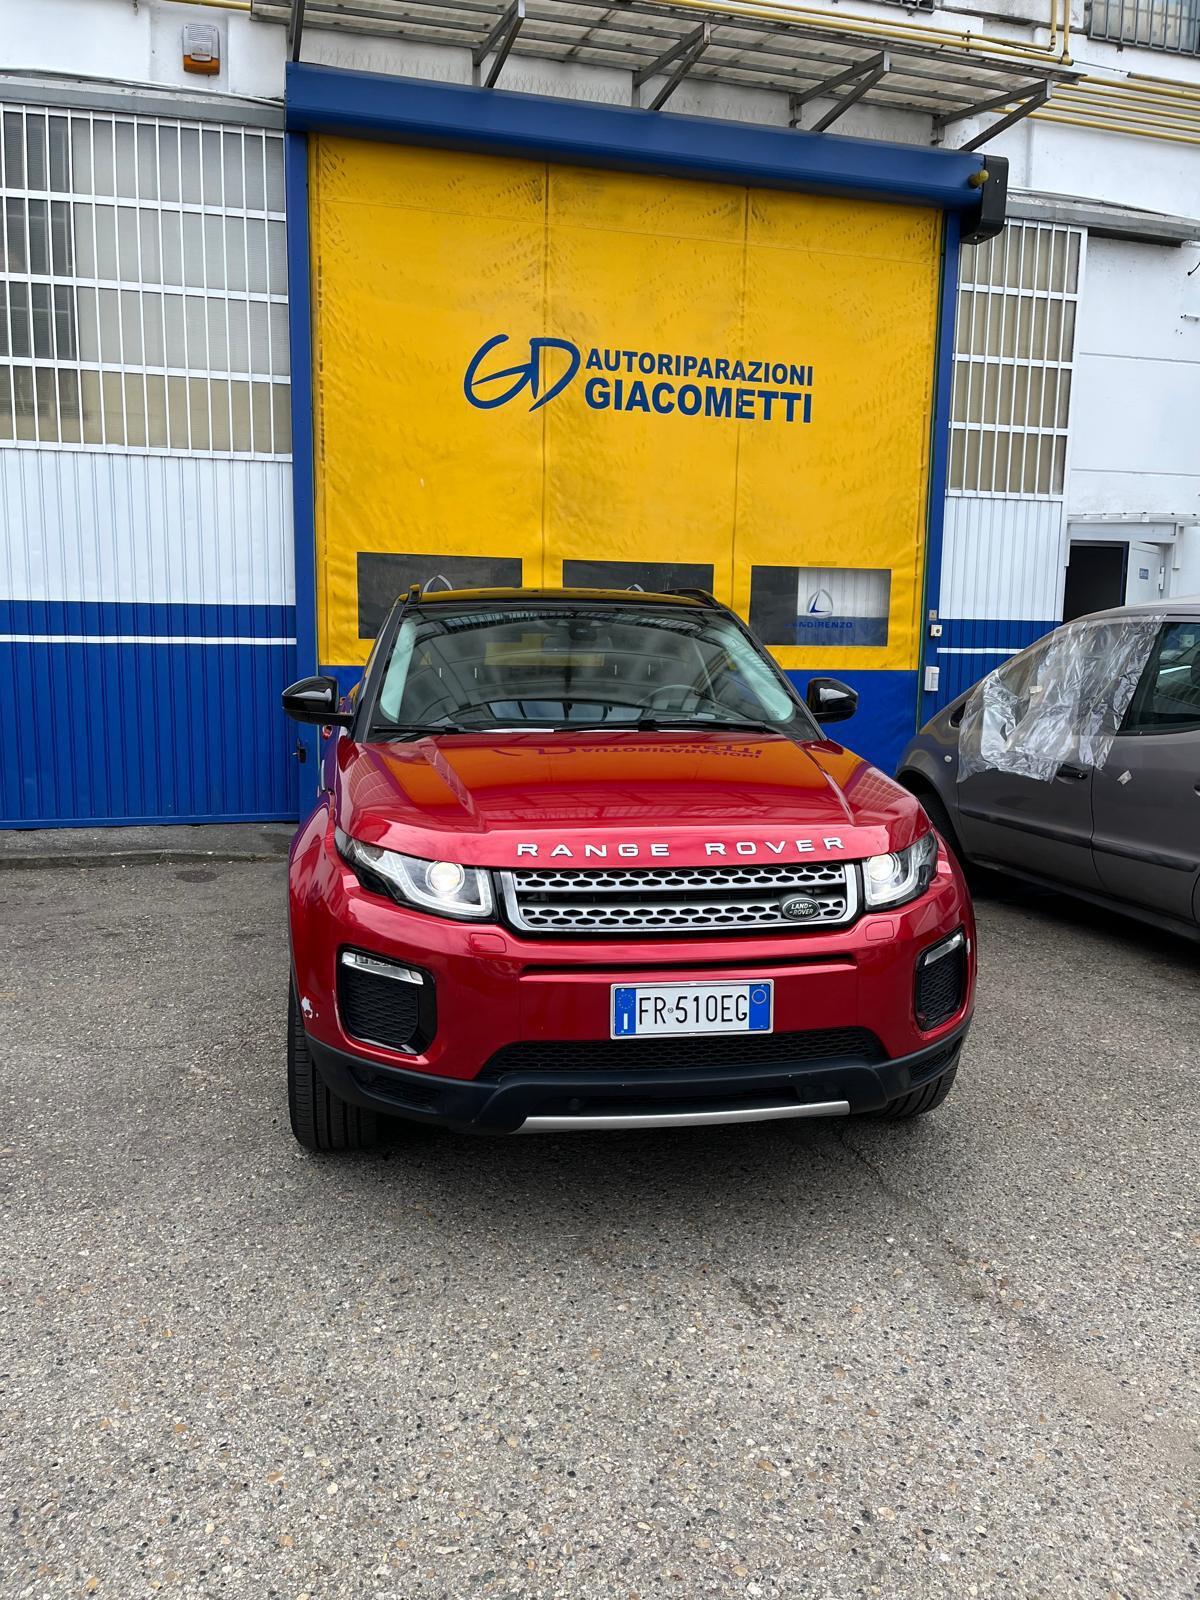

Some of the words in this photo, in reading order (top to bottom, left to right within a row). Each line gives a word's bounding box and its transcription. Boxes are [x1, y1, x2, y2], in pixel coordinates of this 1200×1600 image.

[585, 348, 814, 387] AUTORIPARAZIONI
[584, 377, 812, 424] GIACOMETTI
[516, 843, 670, 857] RANGE
[704, 837, 845, 856] ROVER
